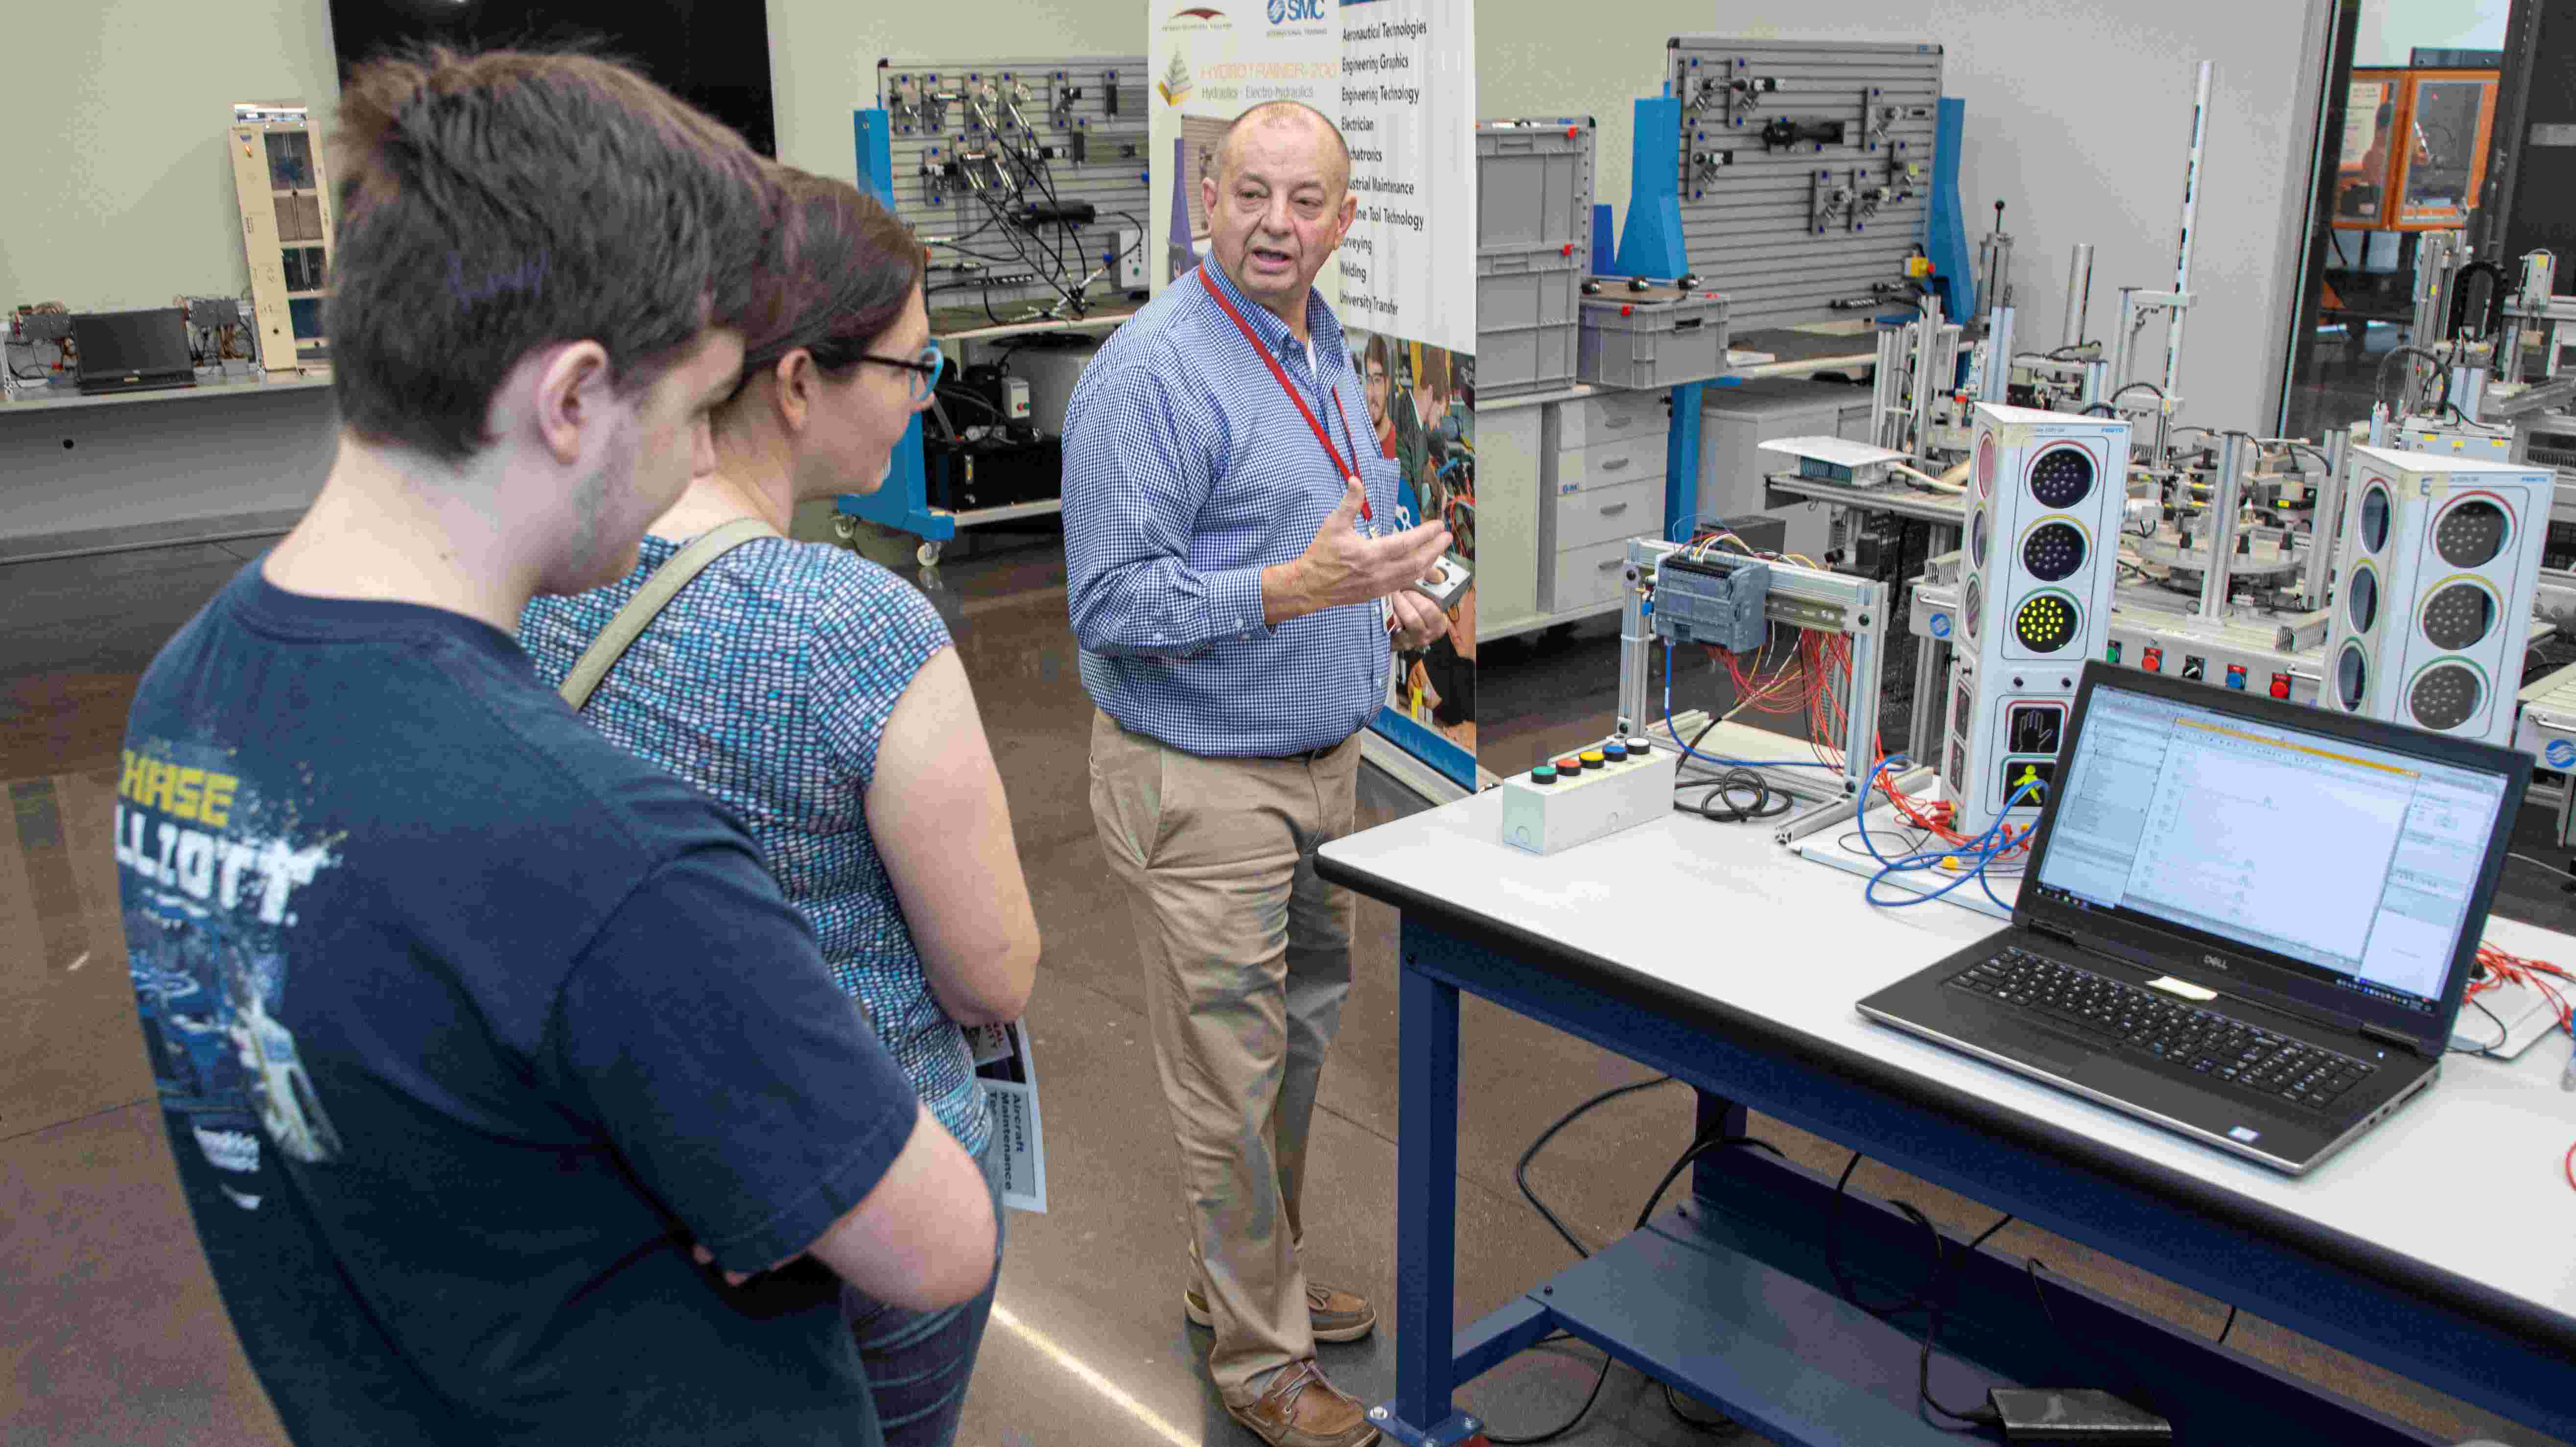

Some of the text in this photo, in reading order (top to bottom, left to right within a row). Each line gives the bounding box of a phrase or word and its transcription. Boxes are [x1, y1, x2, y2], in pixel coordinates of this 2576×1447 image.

[1288, 0, 1325, 21] SMC
[1343, 18, 1427, 42] Aeronautical Technologies
[1342, 52, 1408, 76] Engineering Graphics
[1342, 83, 1420, 105] Engineering Technology
[1341, 116, 1374, 131] Electrician
[1347, 145, 1382, 162] chatronics
[1348, 176, 1414, 195] ustrial Maintenance
[1369, 205, 1382, 222] Tool
[1383, 207, 1424, 233] Technology
[1340, 261, 1366, 284] Welding
[1339, 289, 1399, 315] University Transfer
[120, 749, 239, 828] HASE
[115, 803, 328, 925] LLIOTT
[1012, 1092, 1024, 1152] Aircraft
[1001, 1090, 1012, 1190] Maintenance
